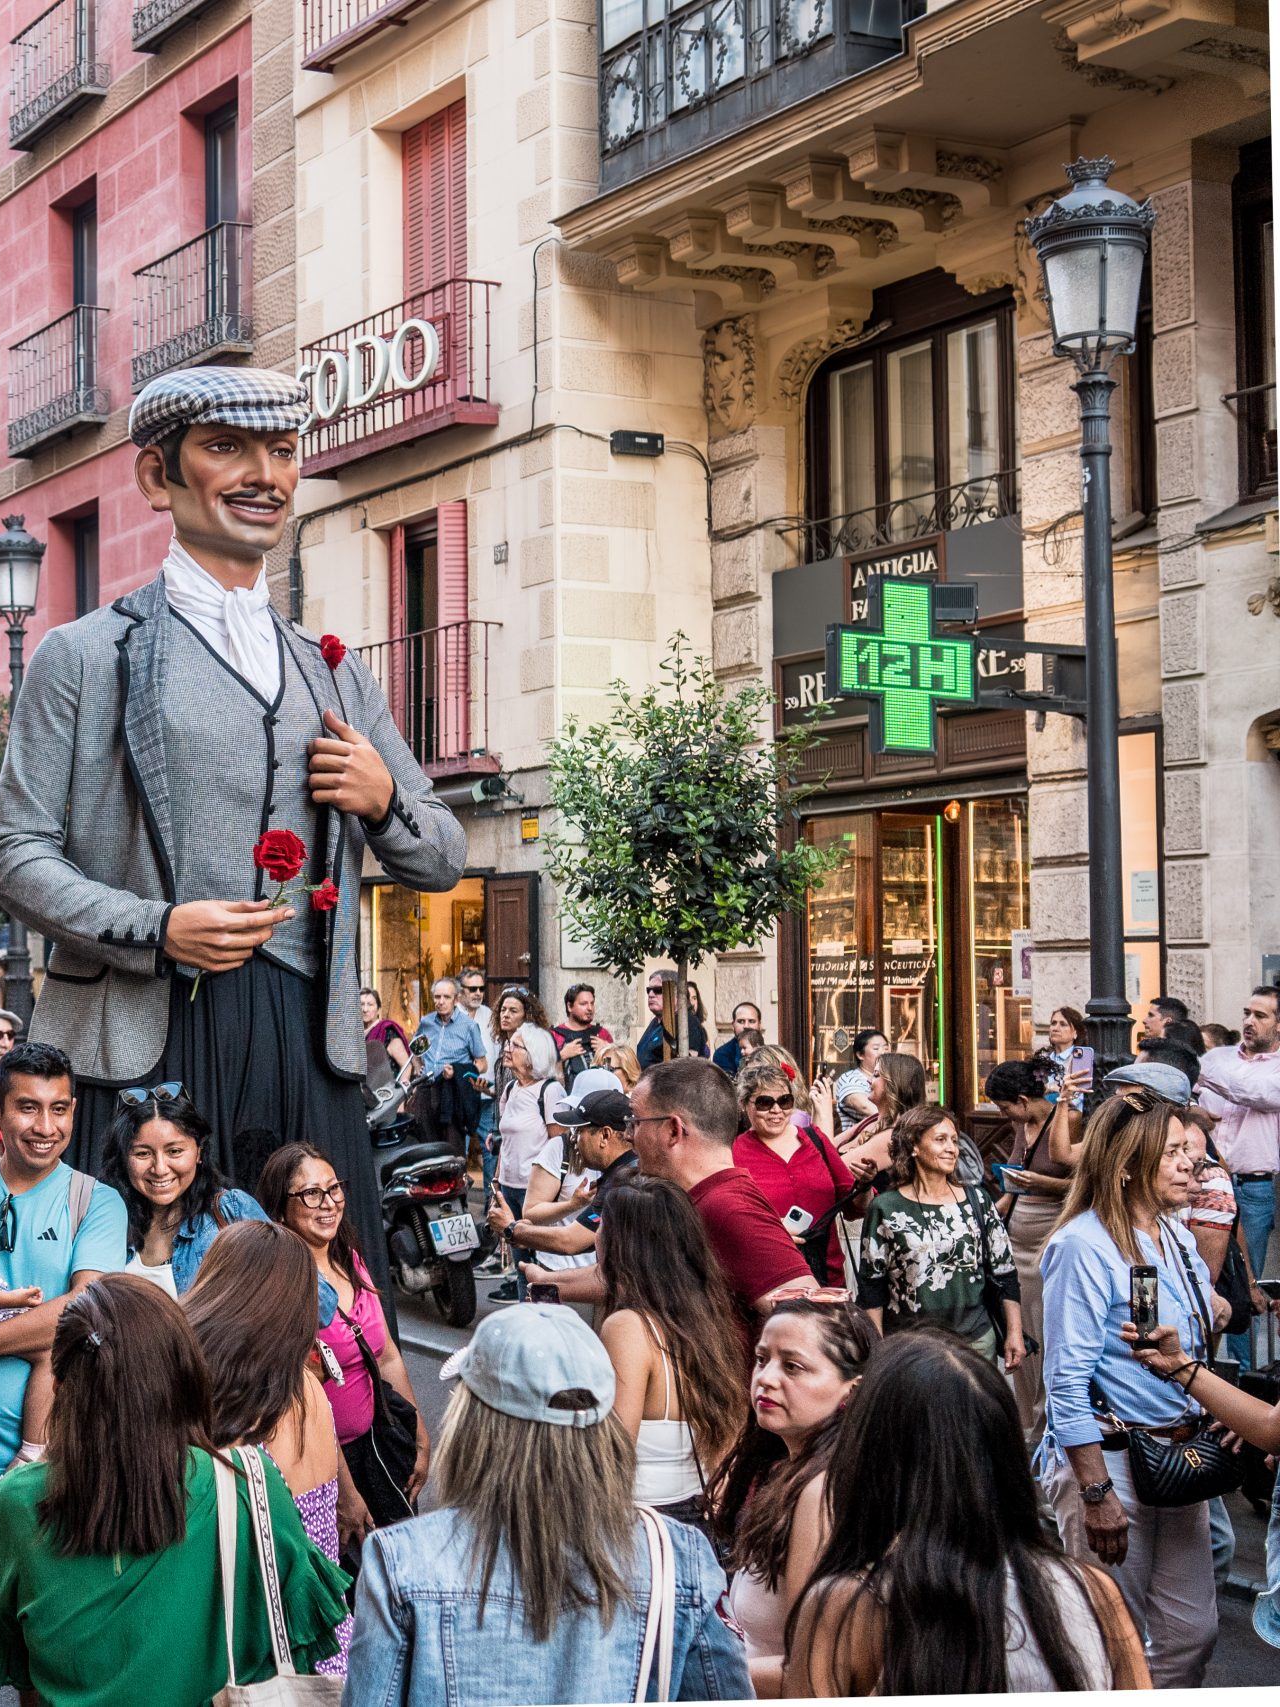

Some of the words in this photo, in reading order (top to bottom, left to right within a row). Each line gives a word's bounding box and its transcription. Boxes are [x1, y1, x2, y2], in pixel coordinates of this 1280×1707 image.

[852, 549, 938, 589] ANTIGUA
[784, 696, 800, 710] 59
[799, 671, 844, 708] RE
[1010, 657, 1026, 673] 59
[441, 1217, 472, 1233] 1234
[448, 1231, 472, 1246] DZK
